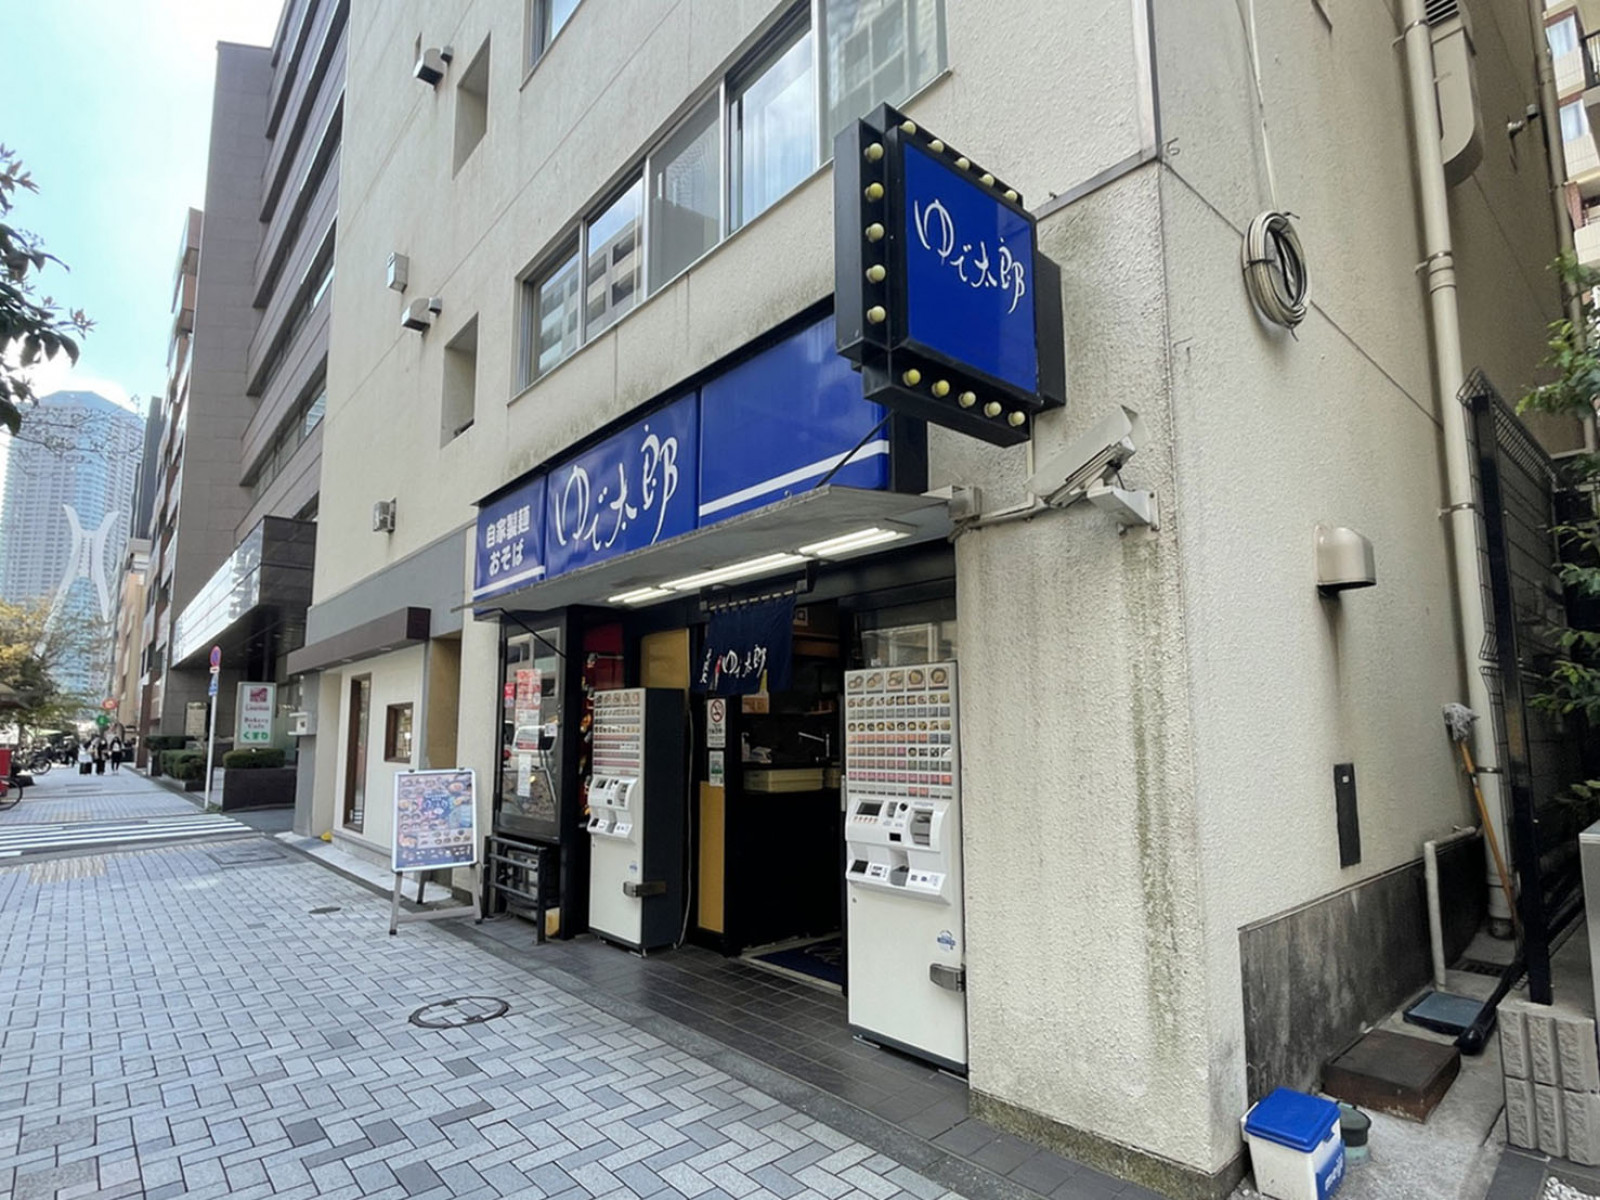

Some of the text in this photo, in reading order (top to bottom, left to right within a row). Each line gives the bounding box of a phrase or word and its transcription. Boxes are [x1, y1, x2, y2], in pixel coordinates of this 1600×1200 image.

[914, 197, 1025, 313] ゆで太郎
[555, 424, 679, 551] ゆで太郎
[486, 504, 531, 549] 自家製麺
[489, 537, 524, 577] おそば
[243, 731, 269, 740] くすり
